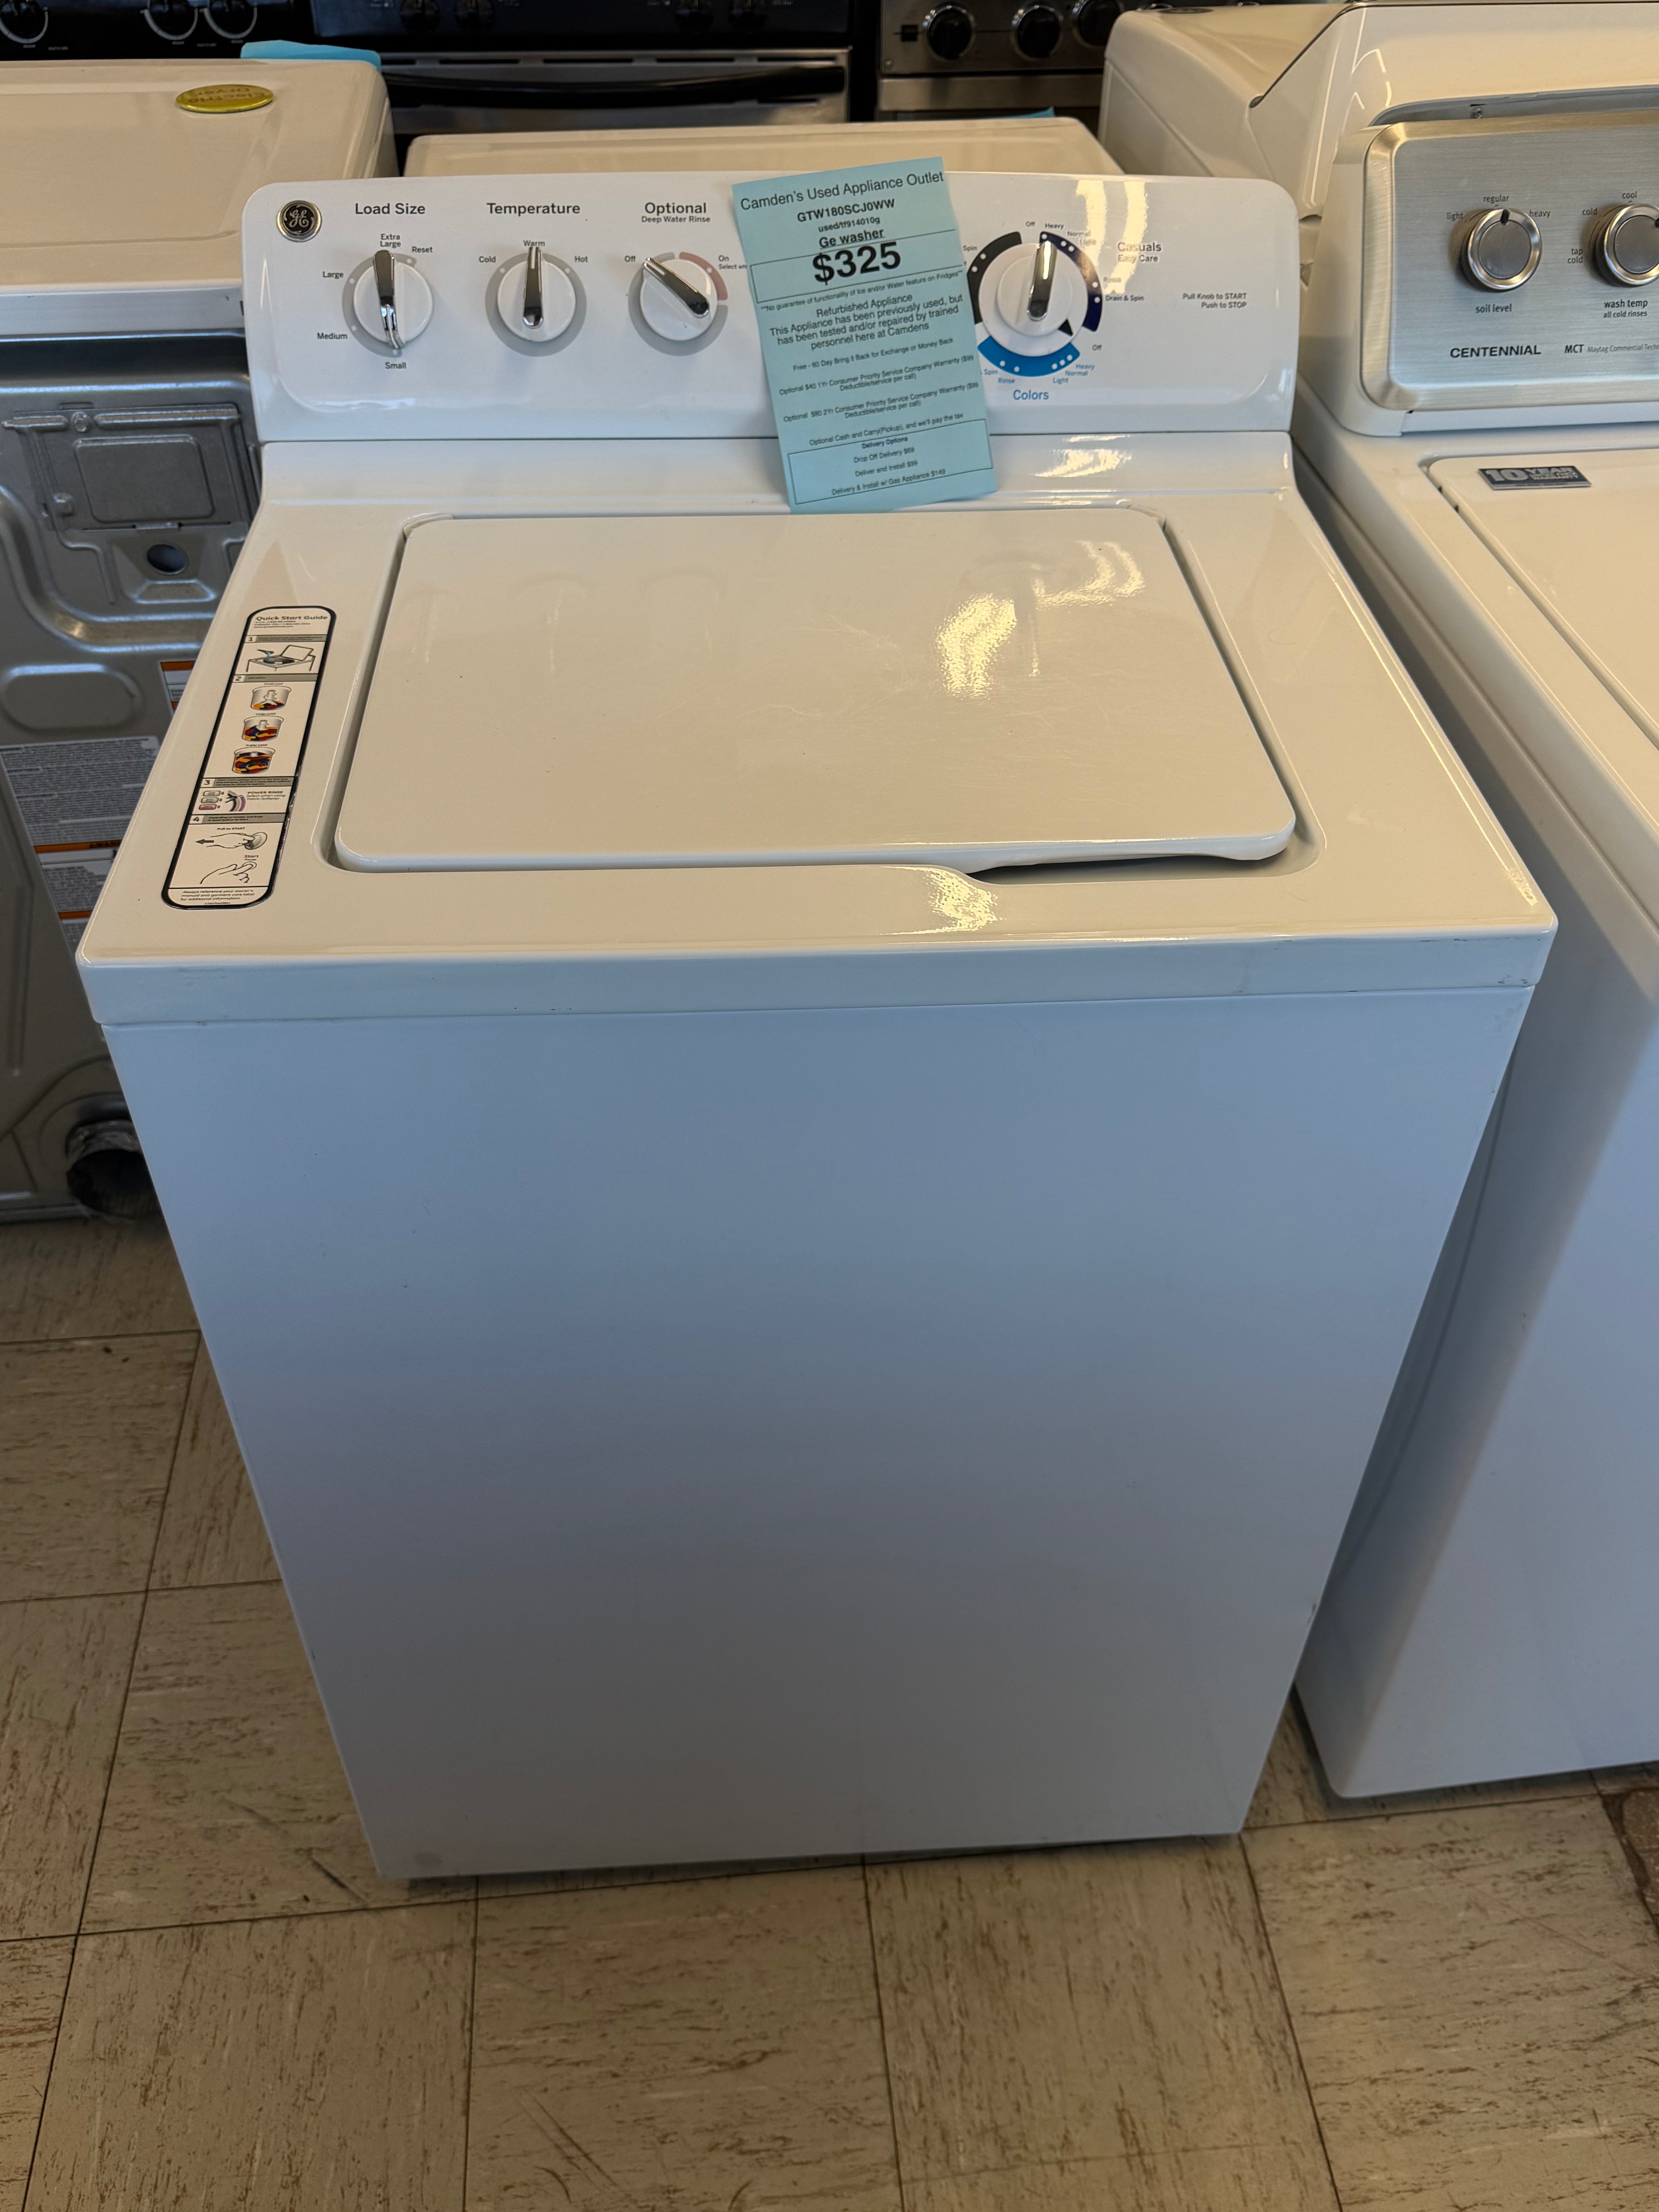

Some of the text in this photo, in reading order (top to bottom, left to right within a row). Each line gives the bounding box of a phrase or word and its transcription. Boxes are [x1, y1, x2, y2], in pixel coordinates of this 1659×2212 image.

[740, 171, 944, 210] Camden's Used Appliance Outlet
[1622, 191, 1637, 199] cool
[1483, 194, 1510, 204] regular
[355, 203, 426, 214] Load Size
[486, 202, 581, 217] Temperature
[644, 202, 707, 216] Optional
[797, 198, 895, 222] GTW180SCJ0WW
[1529, 209, 1551, 218] heavy
[1582, 207, 1598, 216] cold
[641, 216, 662, 224] Deep
[1446, 211, 1464, 222] light
[819, 229, 885, 249] Ge washer
[1117, 242, 1162, 252] Casuals
[1571, 248, 1583, 257] tap
[812, 241, 901, 286] $325
[1138, 254, 1158, 262] Care
[1567, 255, 1583, 264] cold
[322, 271, 344, 279] Large
[816, 294, 913, 318] Refurbished Appliance
[1475, 303, 1512, 314] soil level
[1604, 298, 1648, 310] wash temp
[769, 294, 963, 337] This Appliance has been previously used, but
[777, 305, 959, 346] has been tested and/or repaired by trained
[810, 322, 930, 352] personnel here at Camdens
[880, 347, 909, 356] Exchange
[917, 341, 938, 350] Money
[938, 337, 953, 346] Back
[1449, 344, 1541, 358] CENTENNIAL
[1564, 344, 1585, 354] MCT
[829, 376, 859, 386] Consumer
[881, 368, 904, 377] Service
[904, 362, 932, 372] Company
[1013, 389, 1049, 400] Colors
[834, 404, 865, 413] Consumer
[887, 396, 909, 404] Service
[909, 391, 938, 400] Company
[879, 450, 903, 459] Delivery
[902, 472, 930, 482] Appliance
[1485, 469, 1529, 482] 10
